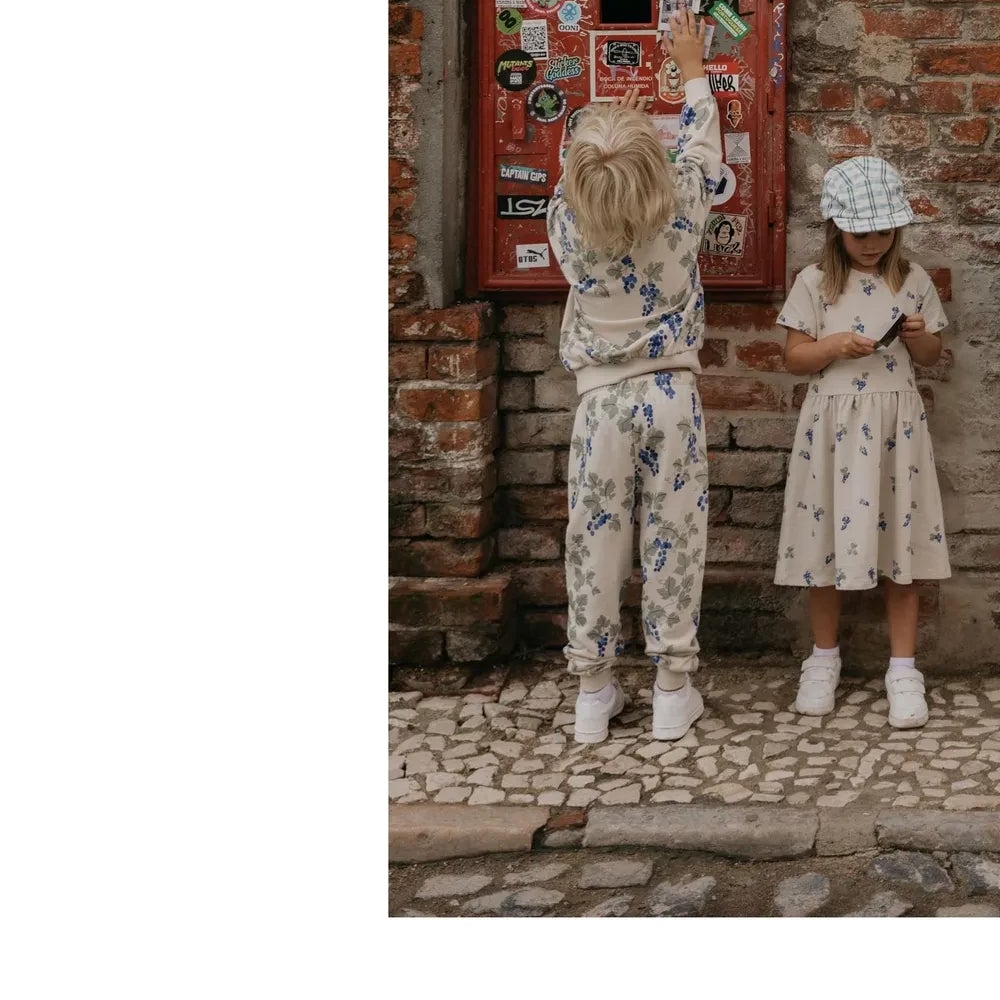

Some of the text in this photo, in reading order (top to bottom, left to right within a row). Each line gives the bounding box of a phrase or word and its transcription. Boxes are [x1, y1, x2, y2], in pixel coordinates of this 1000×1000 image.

[719, 3, 734, 18] COME
[500, 167, 547, 183] CAPTAIN GIPS
